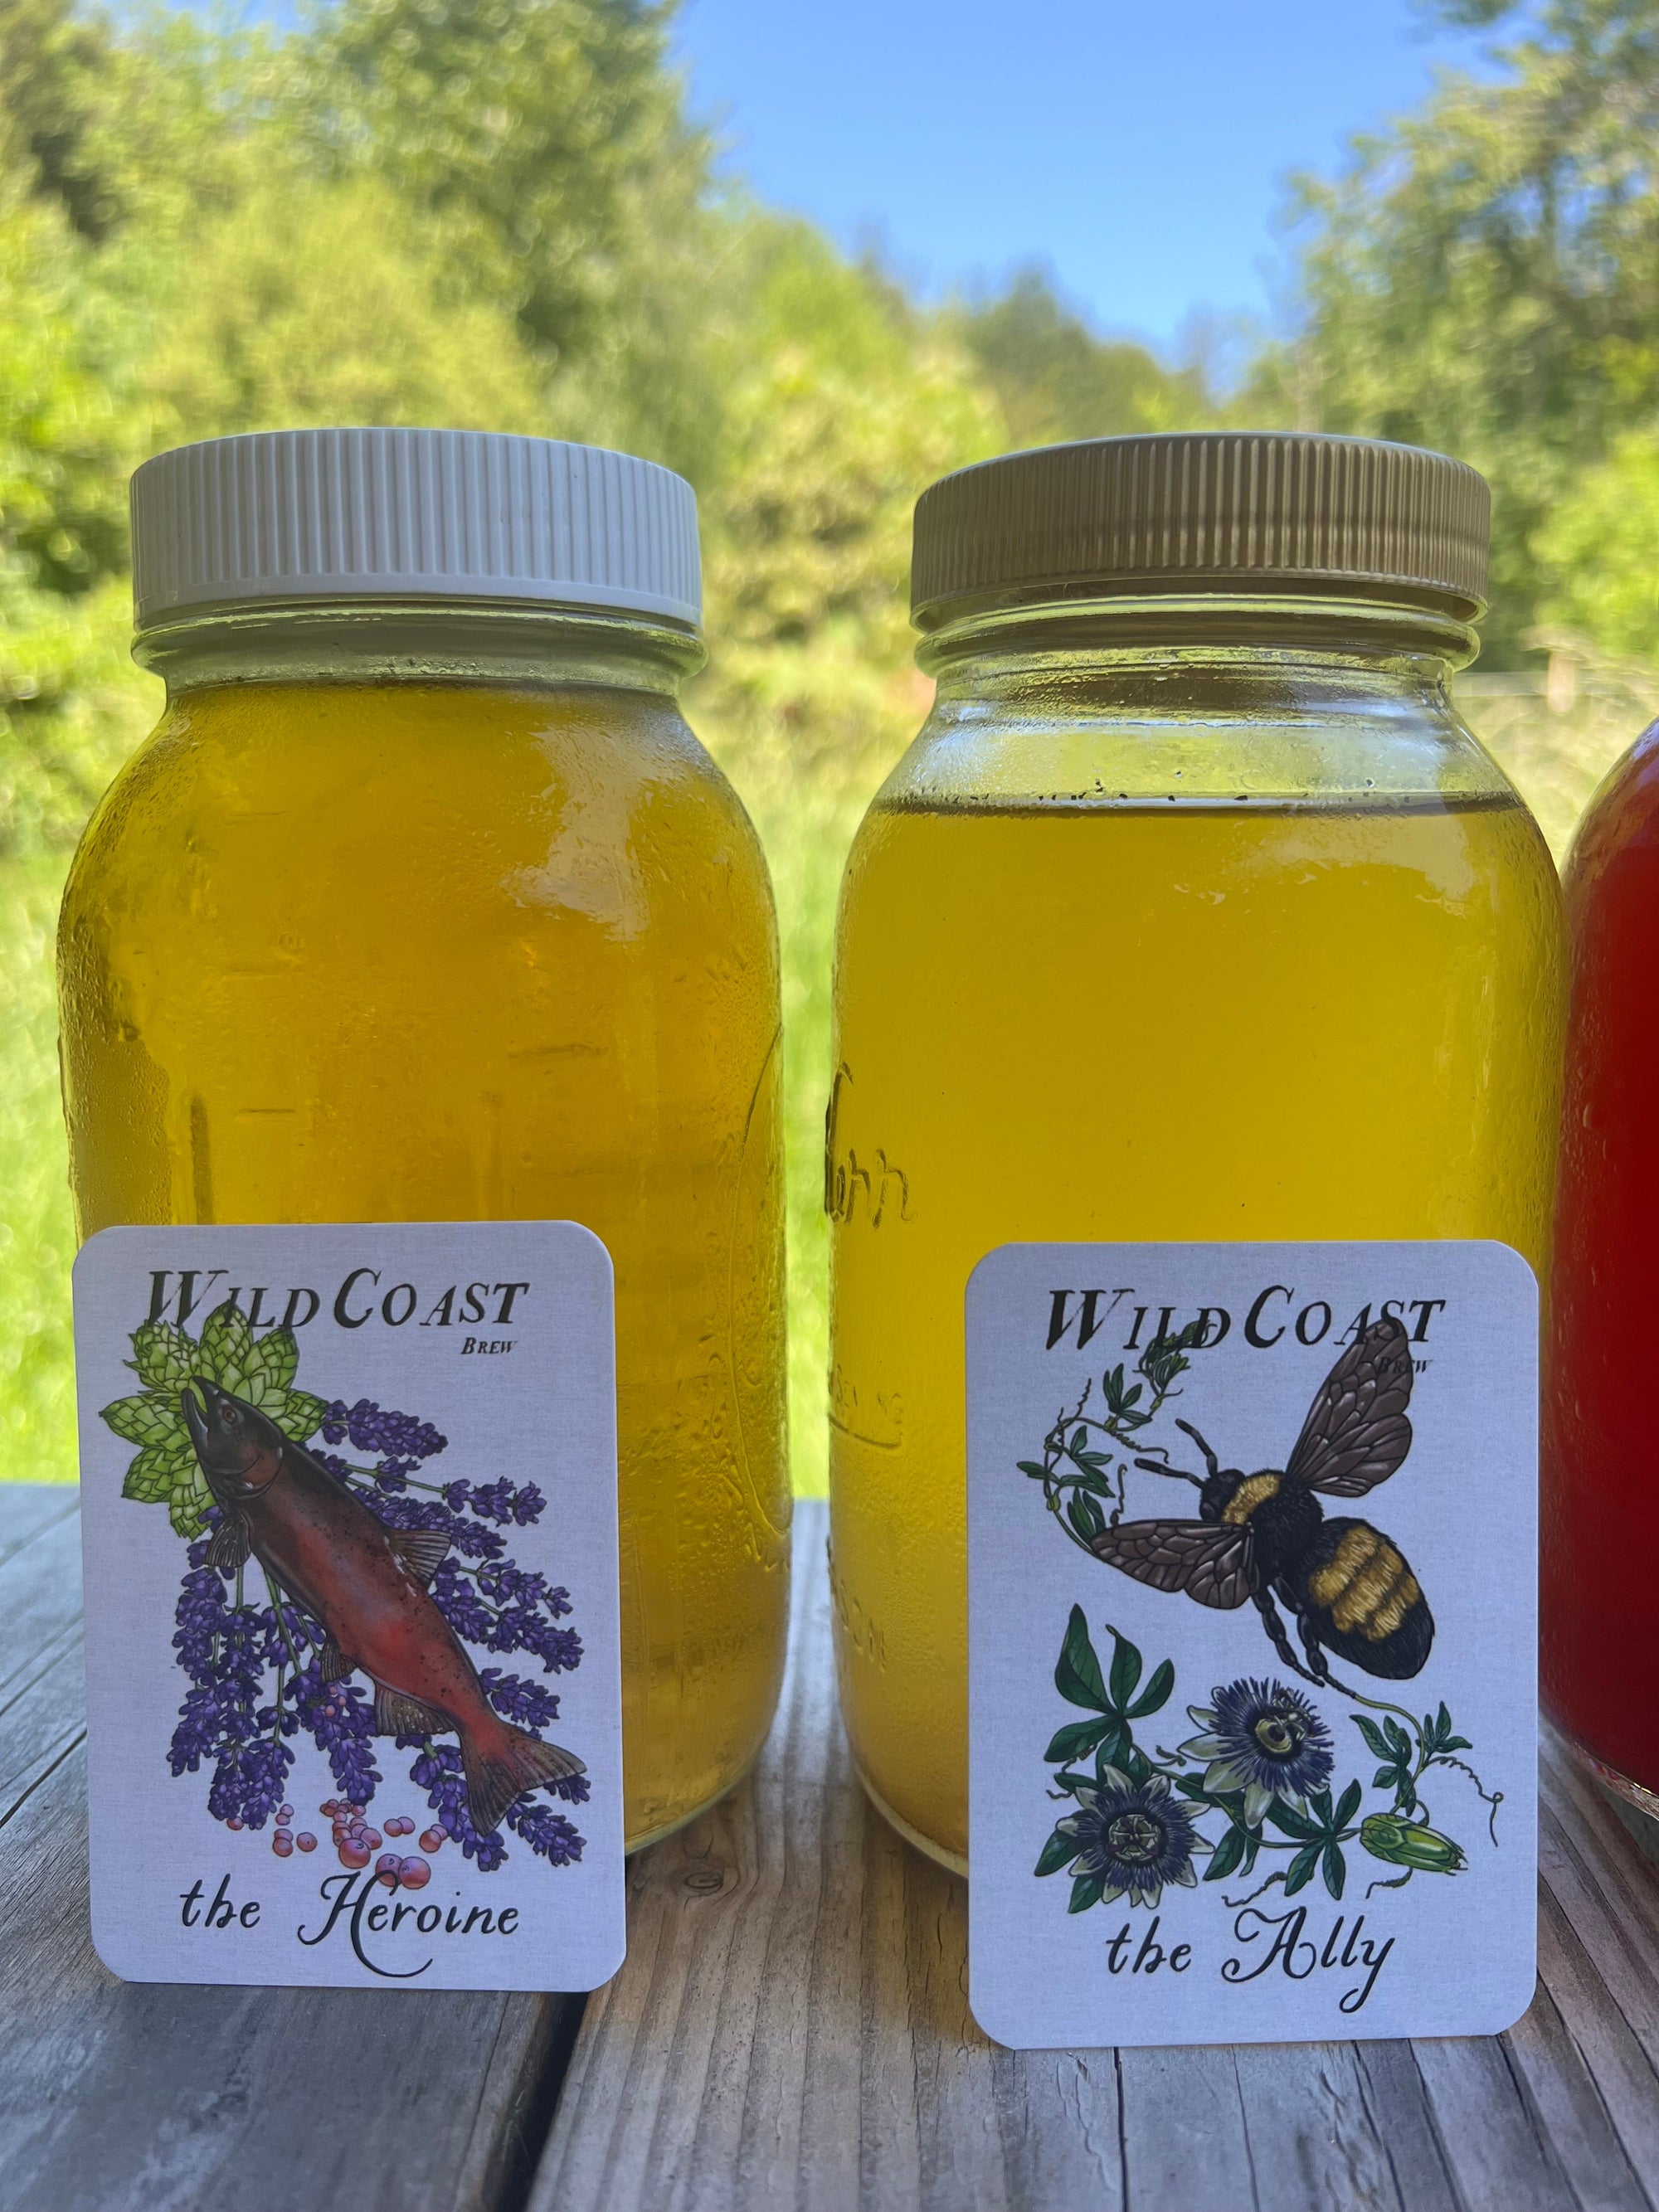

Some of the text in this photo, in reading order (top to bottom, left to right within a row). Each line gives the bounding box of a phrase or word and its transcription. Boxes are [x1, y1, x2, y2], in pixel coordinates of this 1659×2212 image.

[179, 1869, 520, 1978] the Heroine
[1106, 1906, 1395, 2013] the Ally
